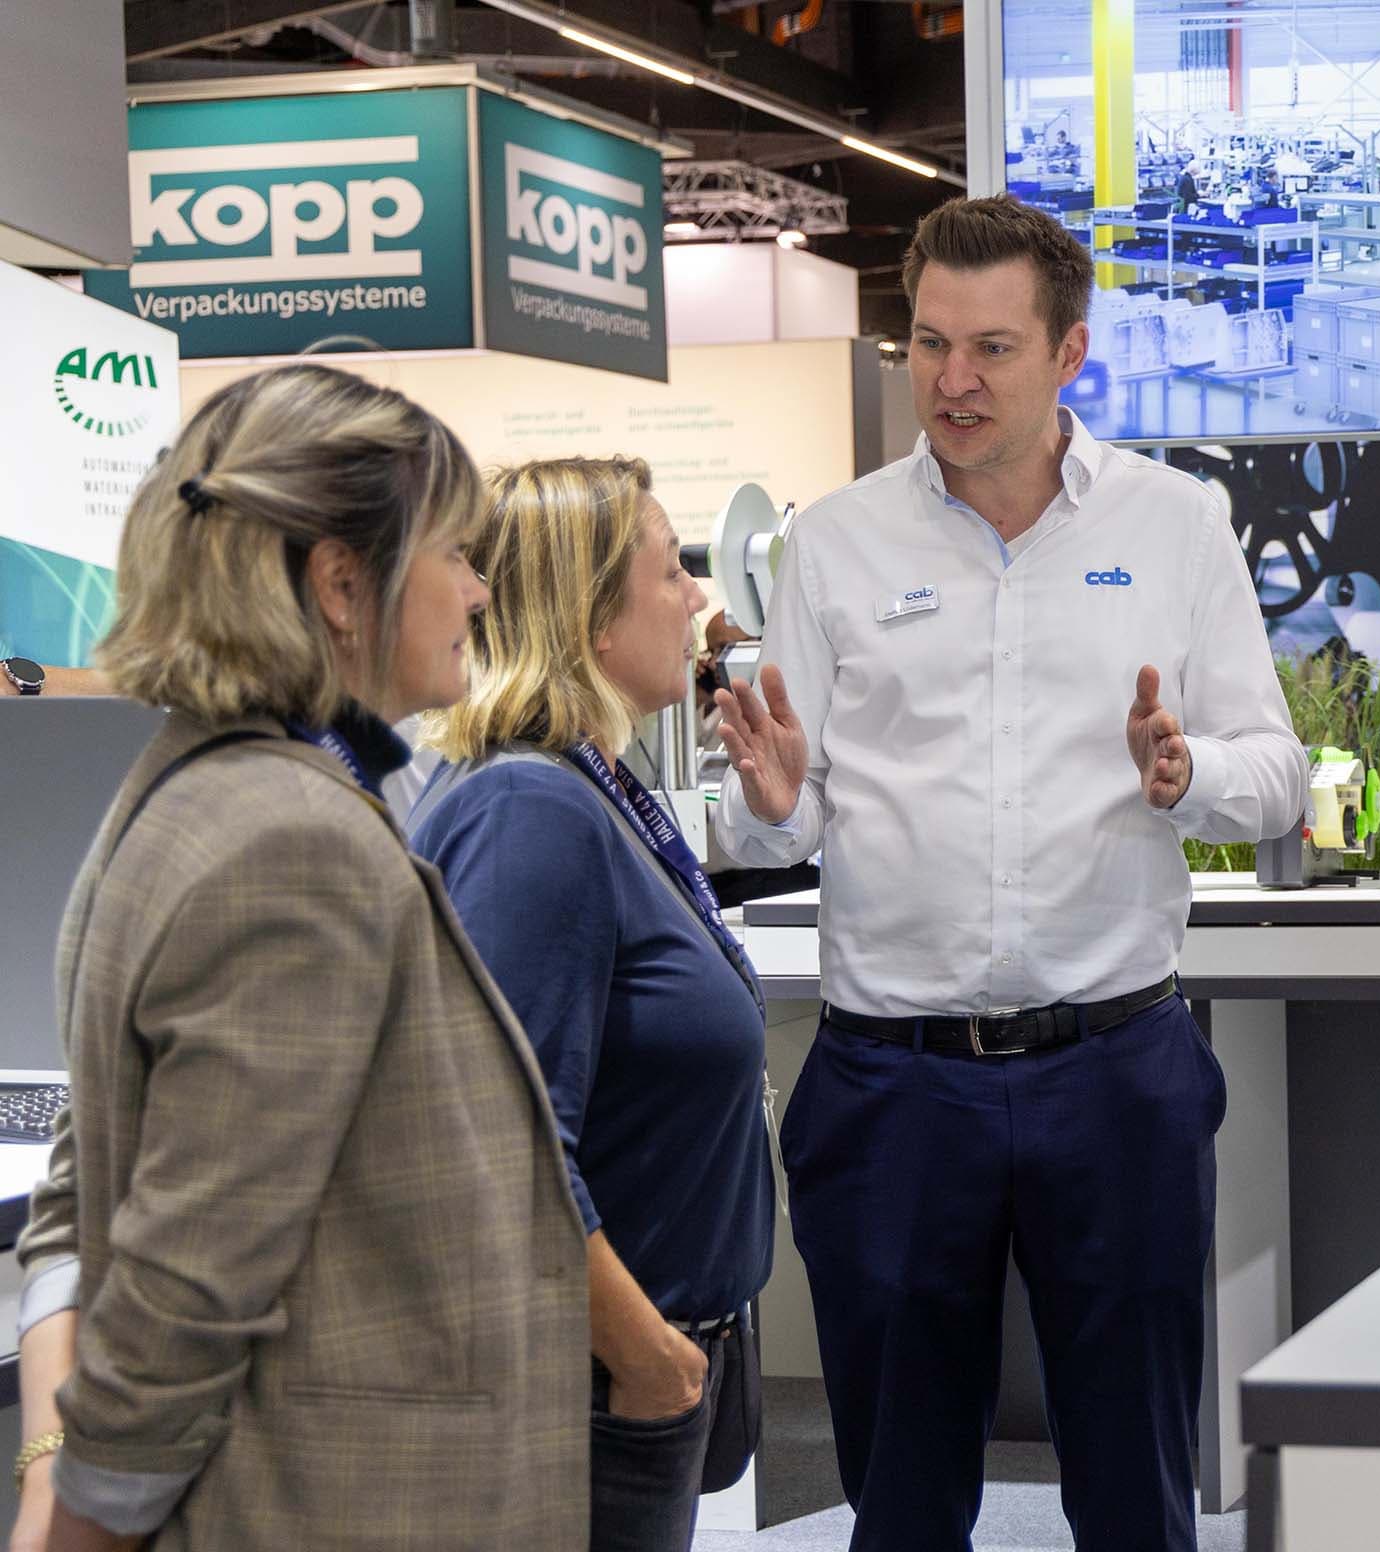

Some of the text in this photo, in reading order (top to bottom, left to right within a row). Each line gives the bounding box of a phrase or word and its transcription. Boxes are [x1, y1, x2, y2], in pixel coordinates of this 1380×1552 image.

[128, 152, 425, 272] kopp
[504, 160, 648, 292] kopp
[133, 284, 427, 323] Verpackungssysteme
[511, 286, 651, 340] Verpackungssysteme
[55, 347, 158, 389] AMI
[904, 587, 934, 600] cab
[1085, 567, 1132, 586] cab
[577, 742, 607, 777] HALLE
[645, 808, 676, 845] HALLE
